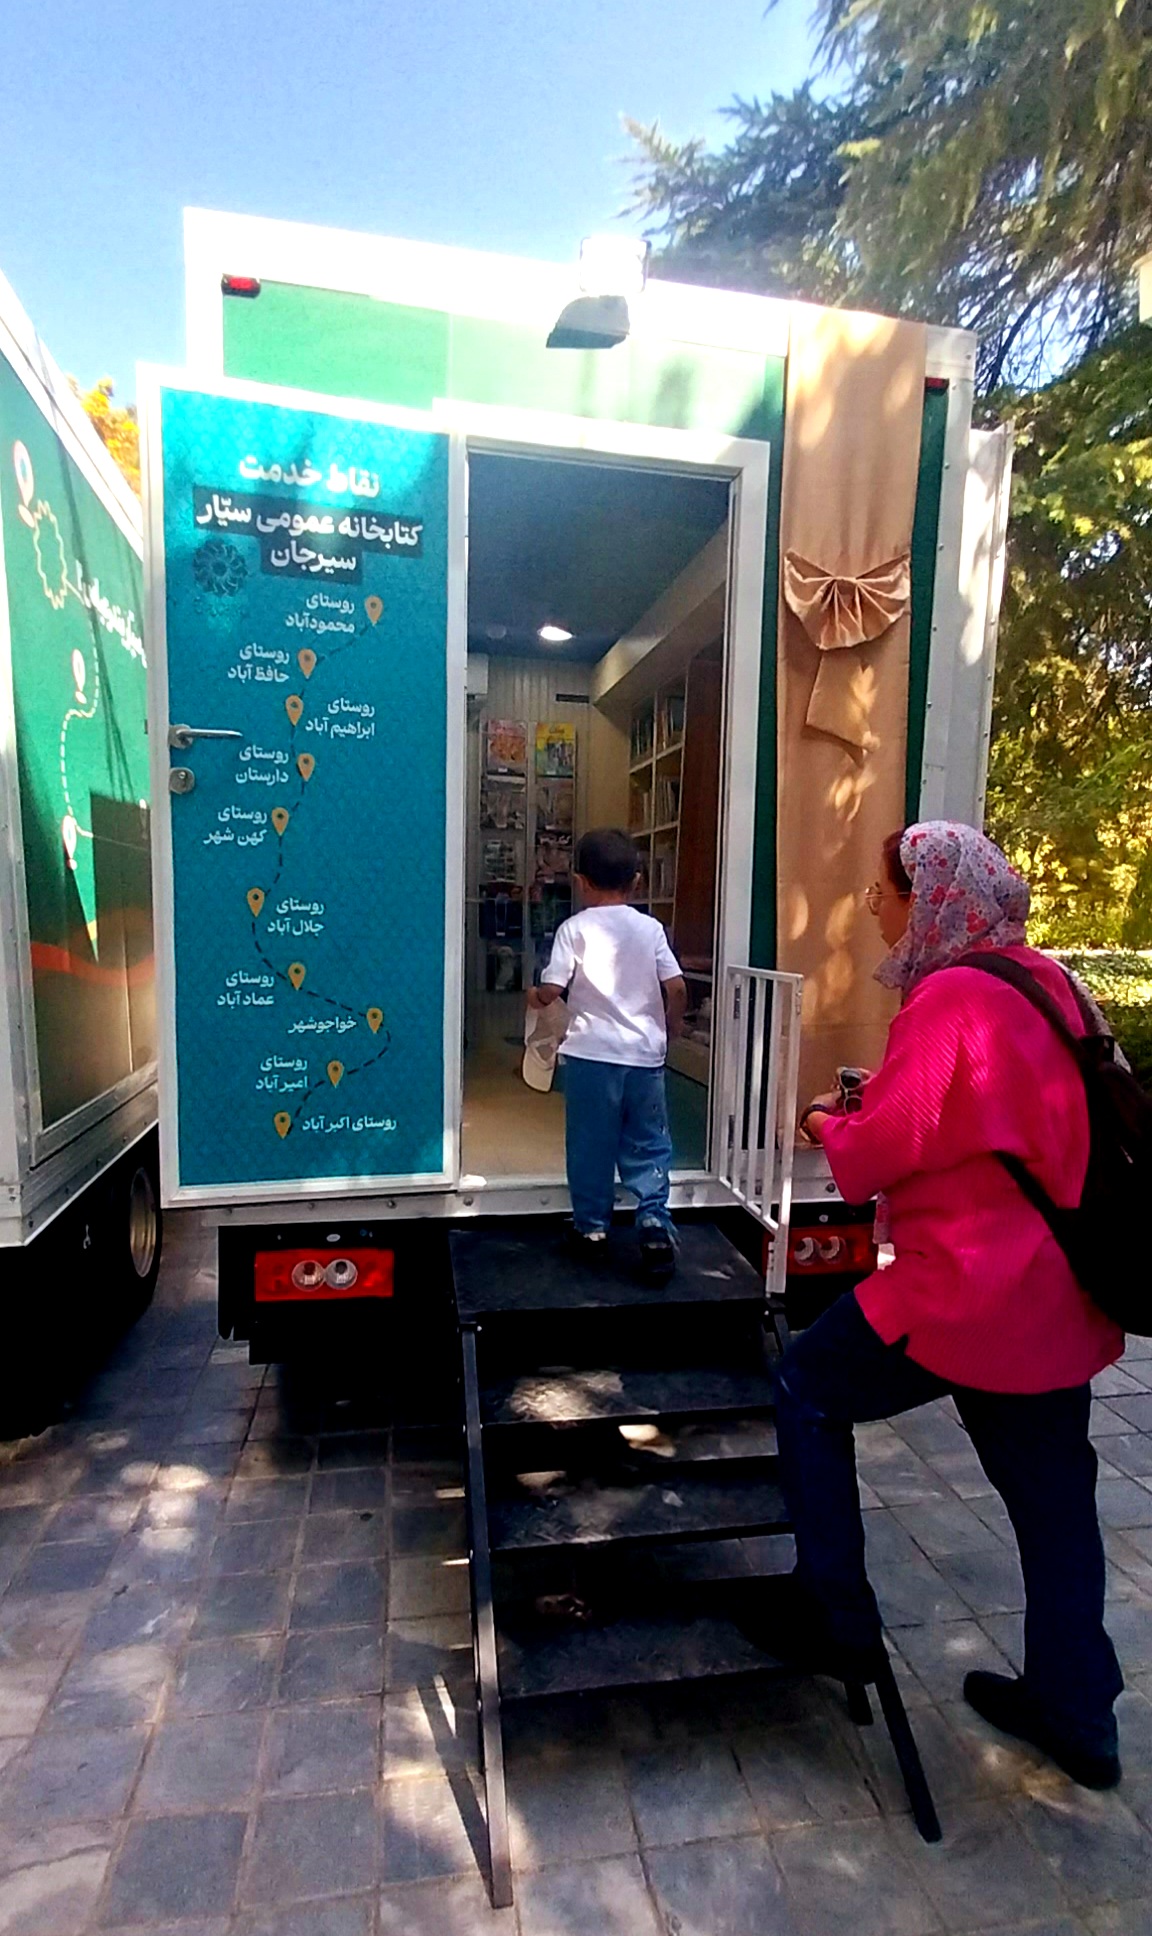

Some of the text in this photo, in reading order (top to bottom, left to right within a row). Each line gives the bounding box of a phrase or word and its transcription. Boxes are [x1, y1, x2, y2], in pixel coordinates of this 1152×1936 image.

[237, 454, 381, 499] نقاط خدمت
[256, 511, 335, 537] عمومی
[338, 514, 424, 549] کتابخانه
[270, 539, 357, 575] سیرجان
[305, 592, 355, 614] روستای
[239, 642, 290, 665] روستای
[327, 697, 375, 718] روستای
[238, 744, 289, 764] روستای
[235, 766, 289, 786] دارستان
[217, 805, 268, 824] روستای
[276, 897, 325, 916] روستای
[225, 970, 275, 988] روستای
[260, 1055, 308, 1072] روستای
[351, 1115, 397, 1132] روستای
